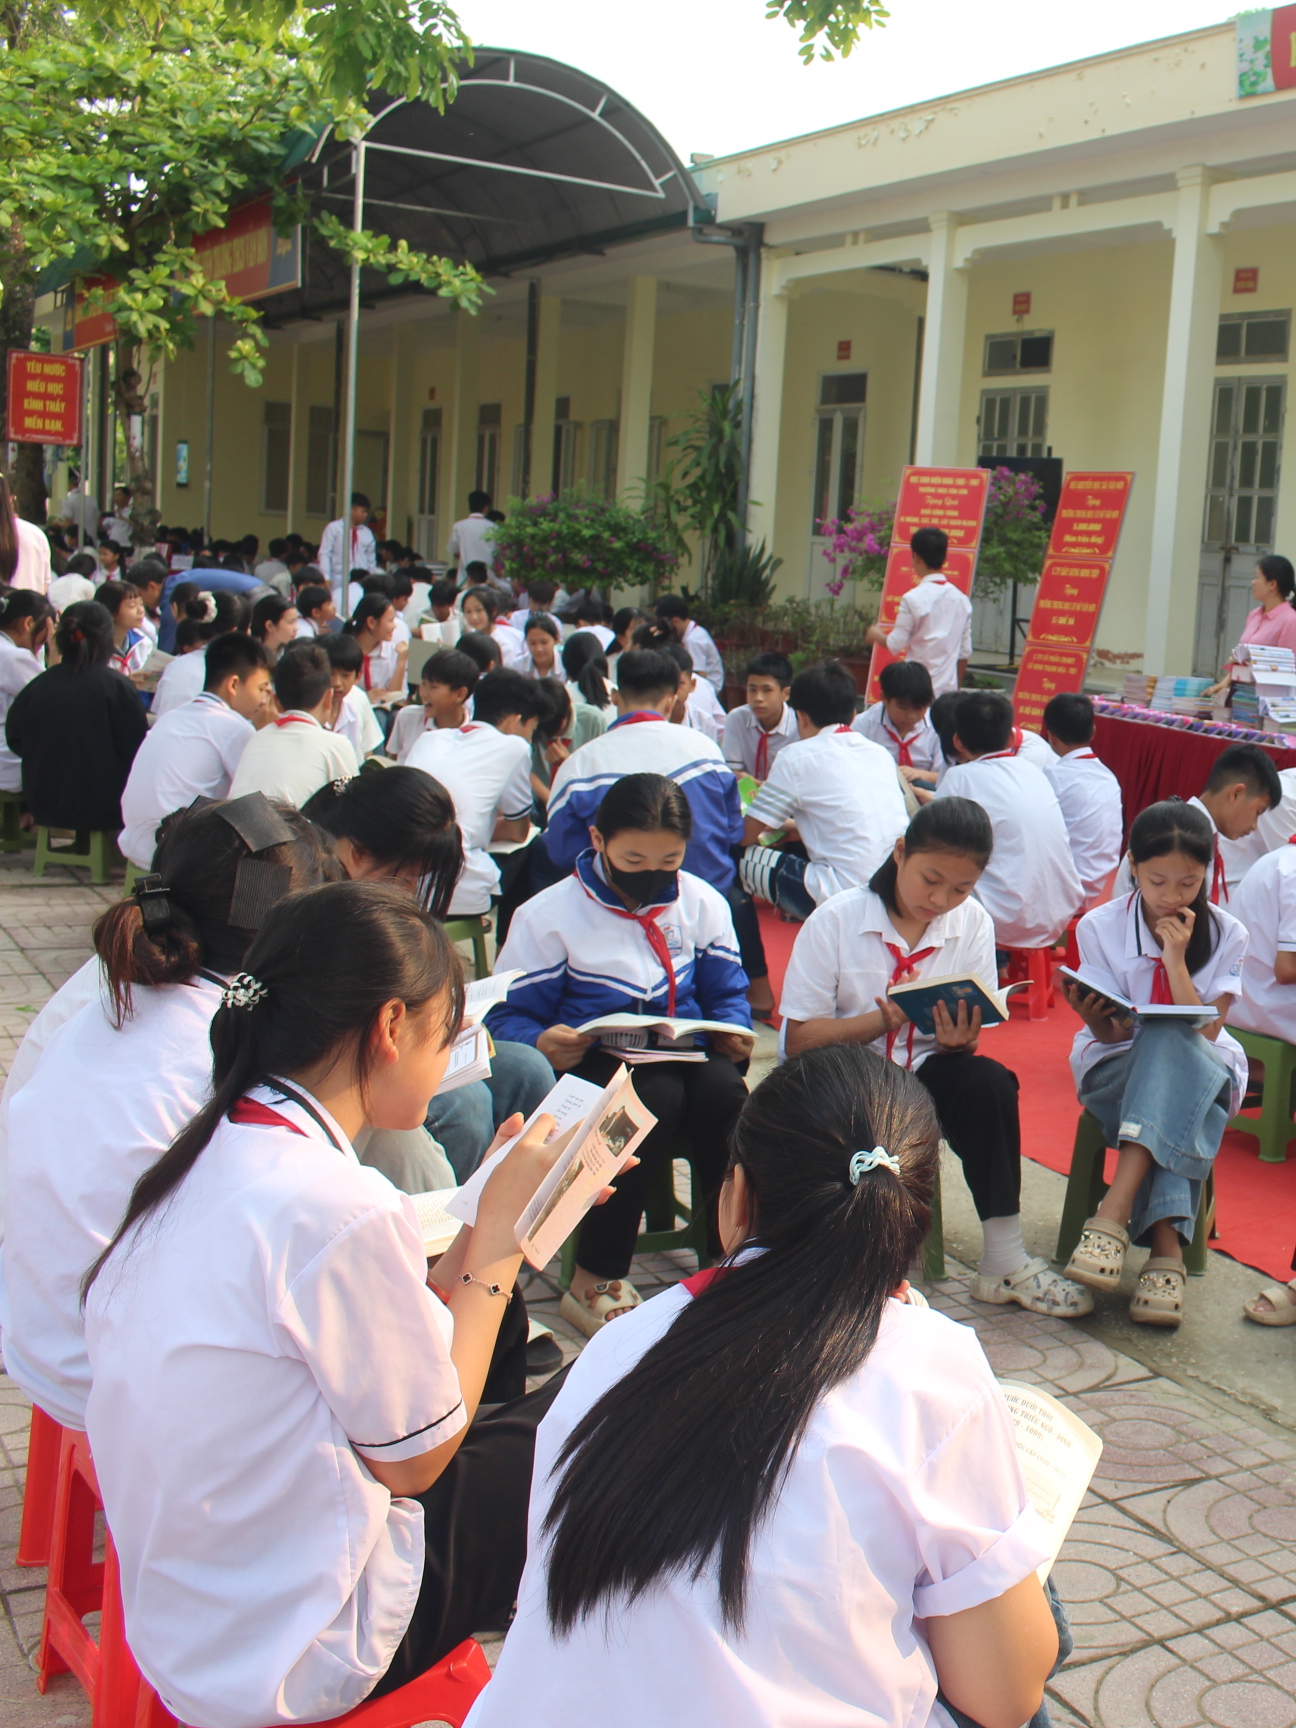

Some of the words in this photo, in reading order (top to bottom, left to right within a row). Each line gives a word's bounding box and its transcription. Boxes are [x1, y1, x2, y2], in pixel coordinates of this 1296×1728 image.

[26, 360, 42, 373] YÊU
[43, 362, 66, 376] NƯỚC
[26, 378, 46, 392] HIẾU
[47, 383, 64, 396] HỌC
[24, 397, 44, 410] KÍNH
[24, 415, 43, 429] MẾN
[44, 419, 64, 433] BẠN.
